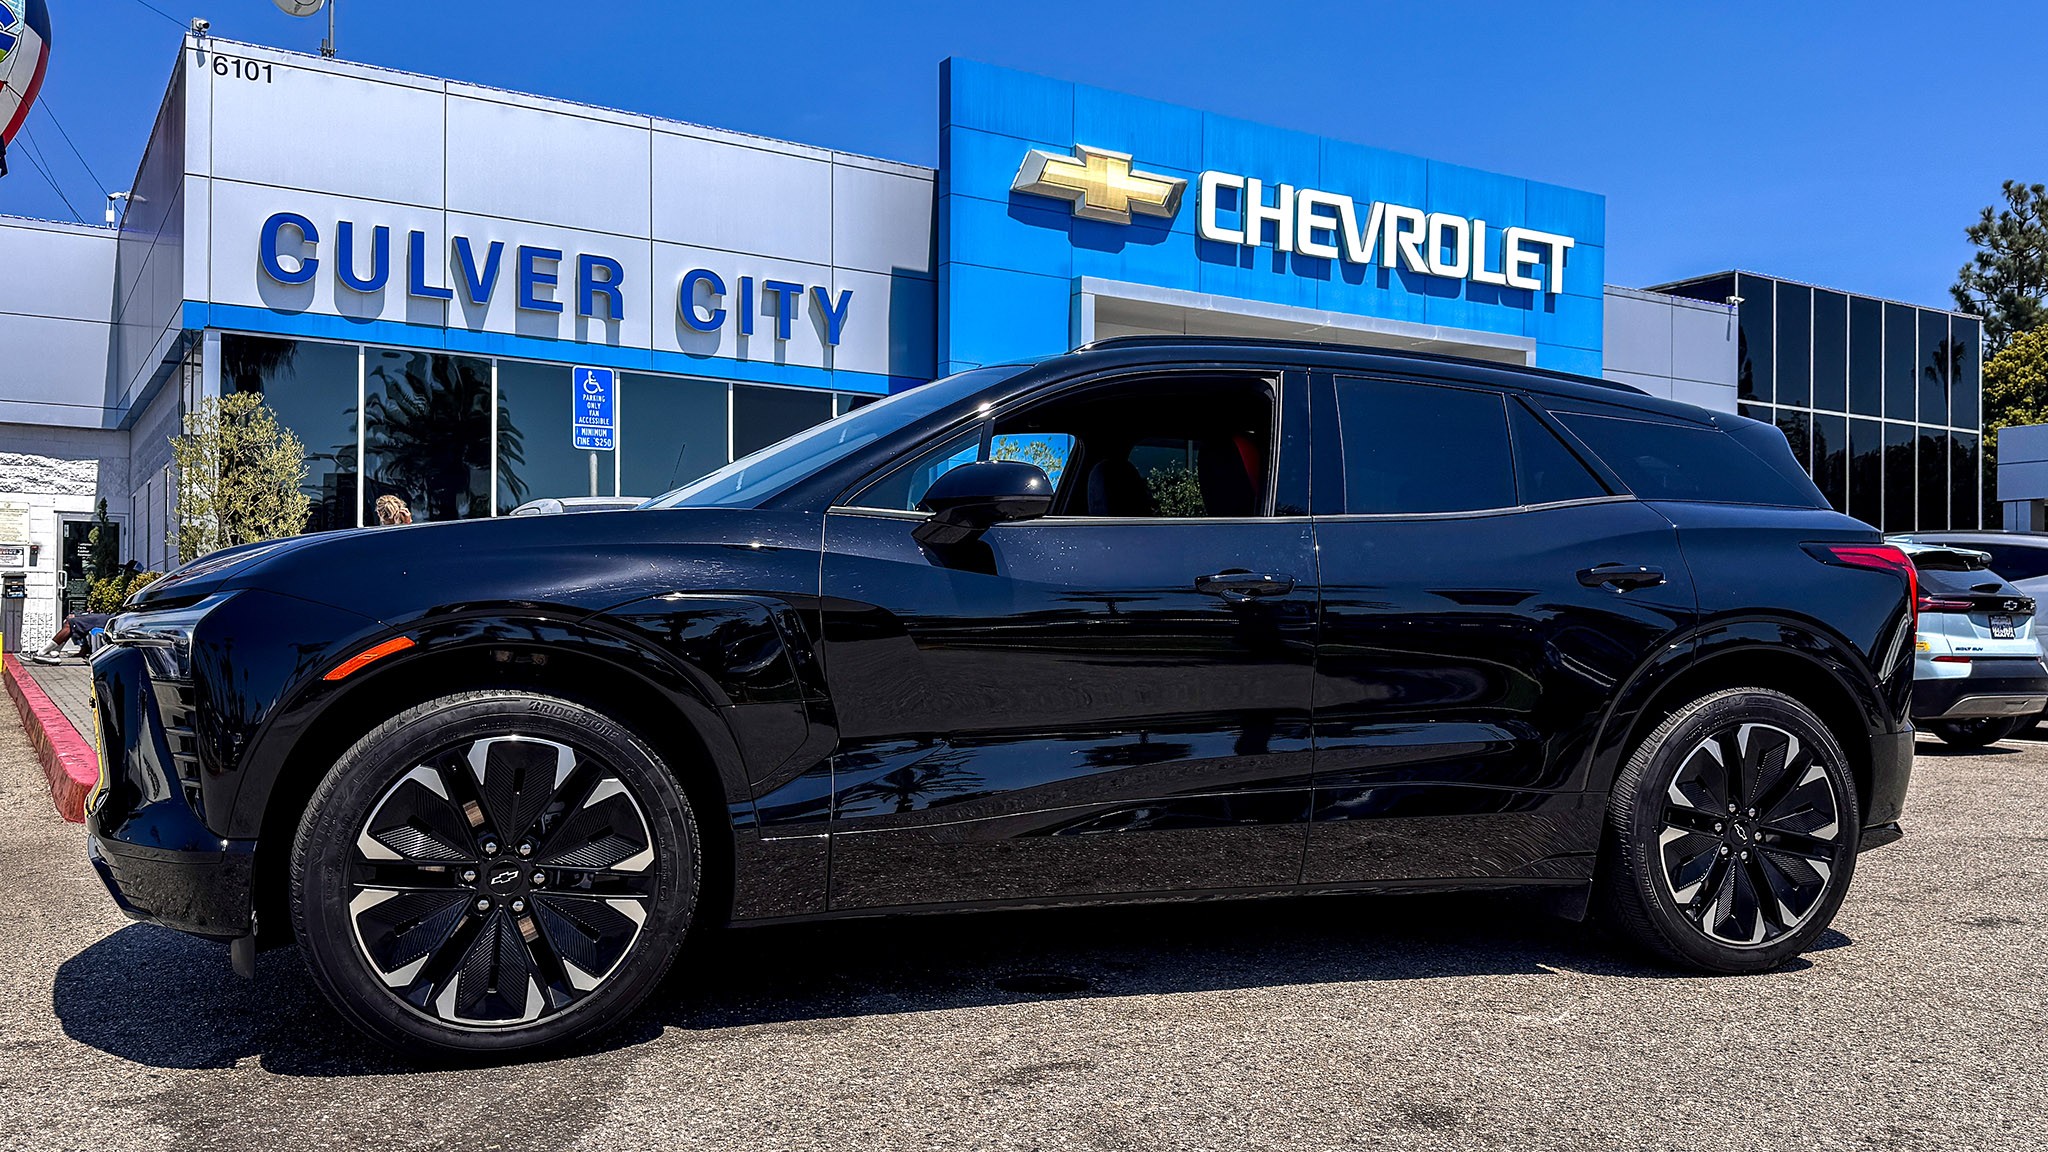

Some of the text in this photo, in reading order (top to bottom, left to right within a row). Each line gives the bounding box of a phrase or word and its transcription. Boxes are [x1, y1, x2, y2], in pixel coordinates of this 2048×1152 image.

[212, 54, 273, 84] 6101
[1198, 169, 1576, 295] CHEVROLET
[258, 212, 855, 347] CULVER CITY
[583, 394, 606, 402] PARKING
[579, 417, 610, 425] ACCESSIBLE
[577, 437, 612, 447] FINE $250
[581, 428, 607, 437] MINIMUM
[527, 699, 620, 739] BRIDGESTONE
